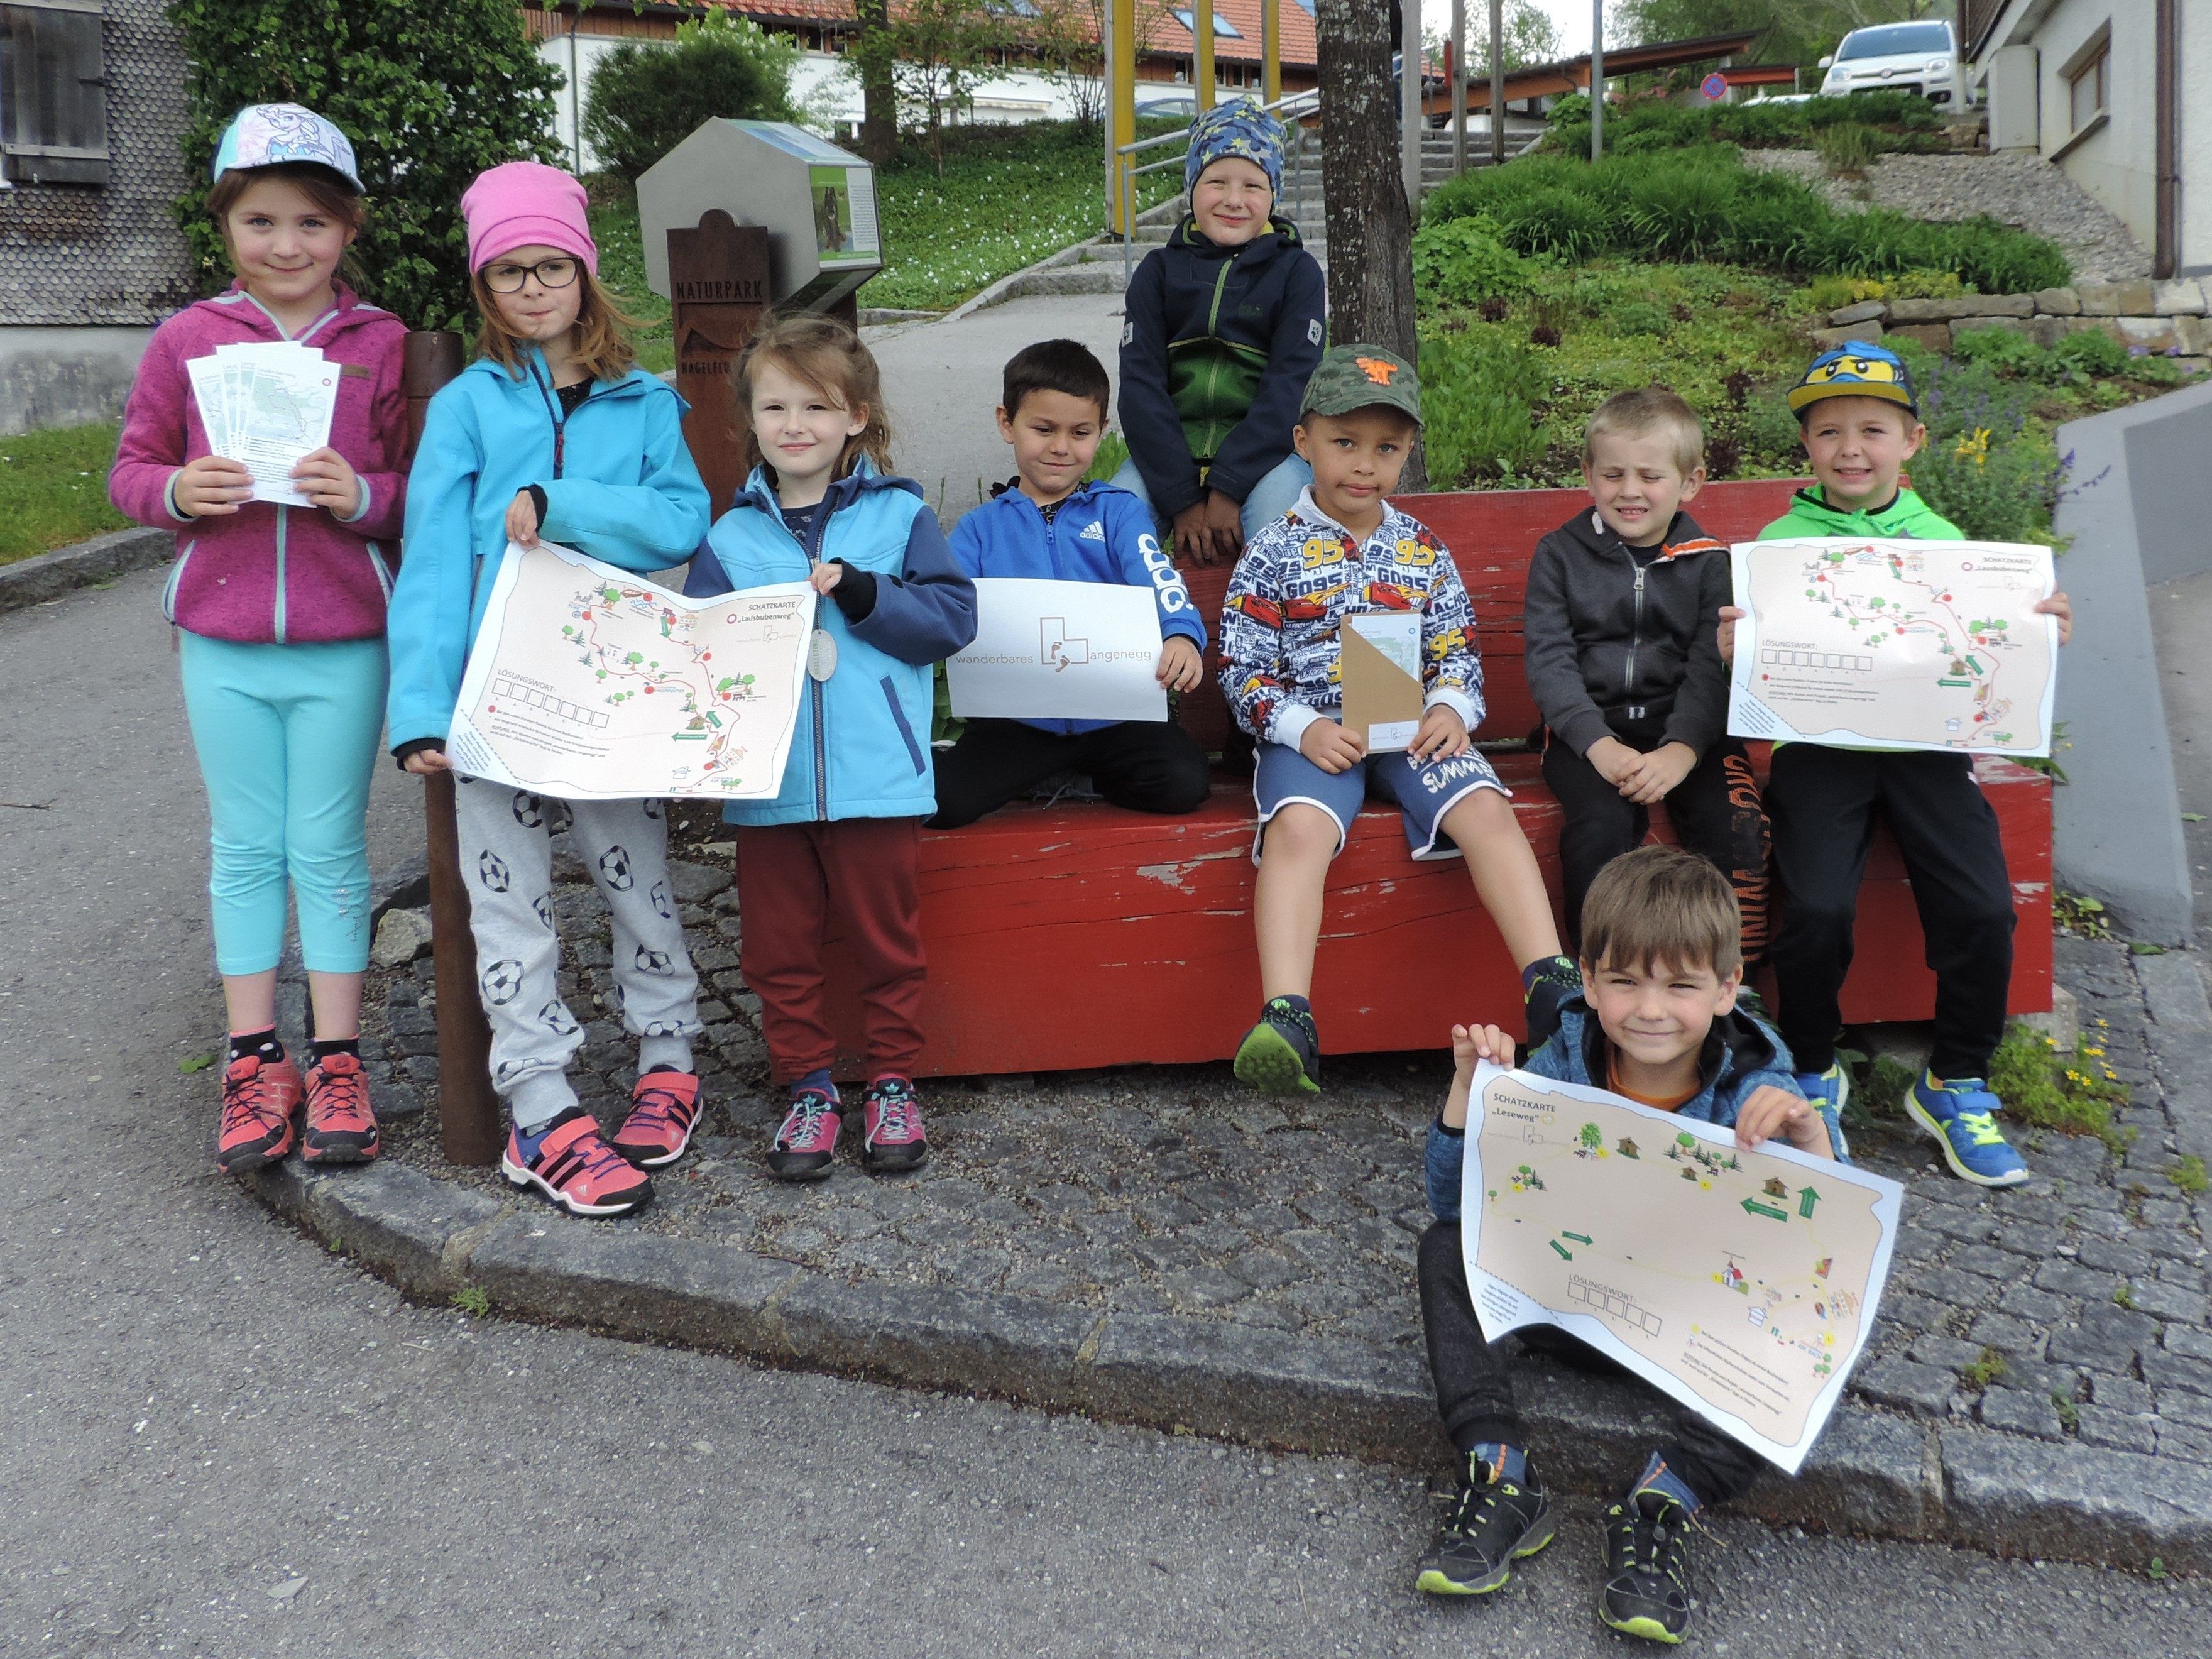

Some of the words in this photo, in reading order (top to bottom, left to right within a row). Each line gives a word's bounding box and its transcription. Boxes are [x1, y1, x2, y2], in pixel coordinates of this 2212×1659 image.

[676, 280, 762, 299] NATURPARK
[1302, 539, 1345, 570] 95
[1394, 539, 1437, 566] 95
[1247, 556, 1278, 579] 95
[1377, 567, 1428, 592] GO95
[1286, 572, 1343, 598] GO95
[748, 601, 796, 611] SCHATZKARTE
[1429, 627, 1466, 661] 95
[956, 653, 1034, 664] wanderbares
[498, 669, 557, 694] LÖSUNGSWORT:
[1492, 1107, 1539, 1122] „Leseweg“
[1493, 1093, 1556, 1113] SCHATZKARTE
[1569, 1274, 1636, 1303] LÖSUNGSWORT:
